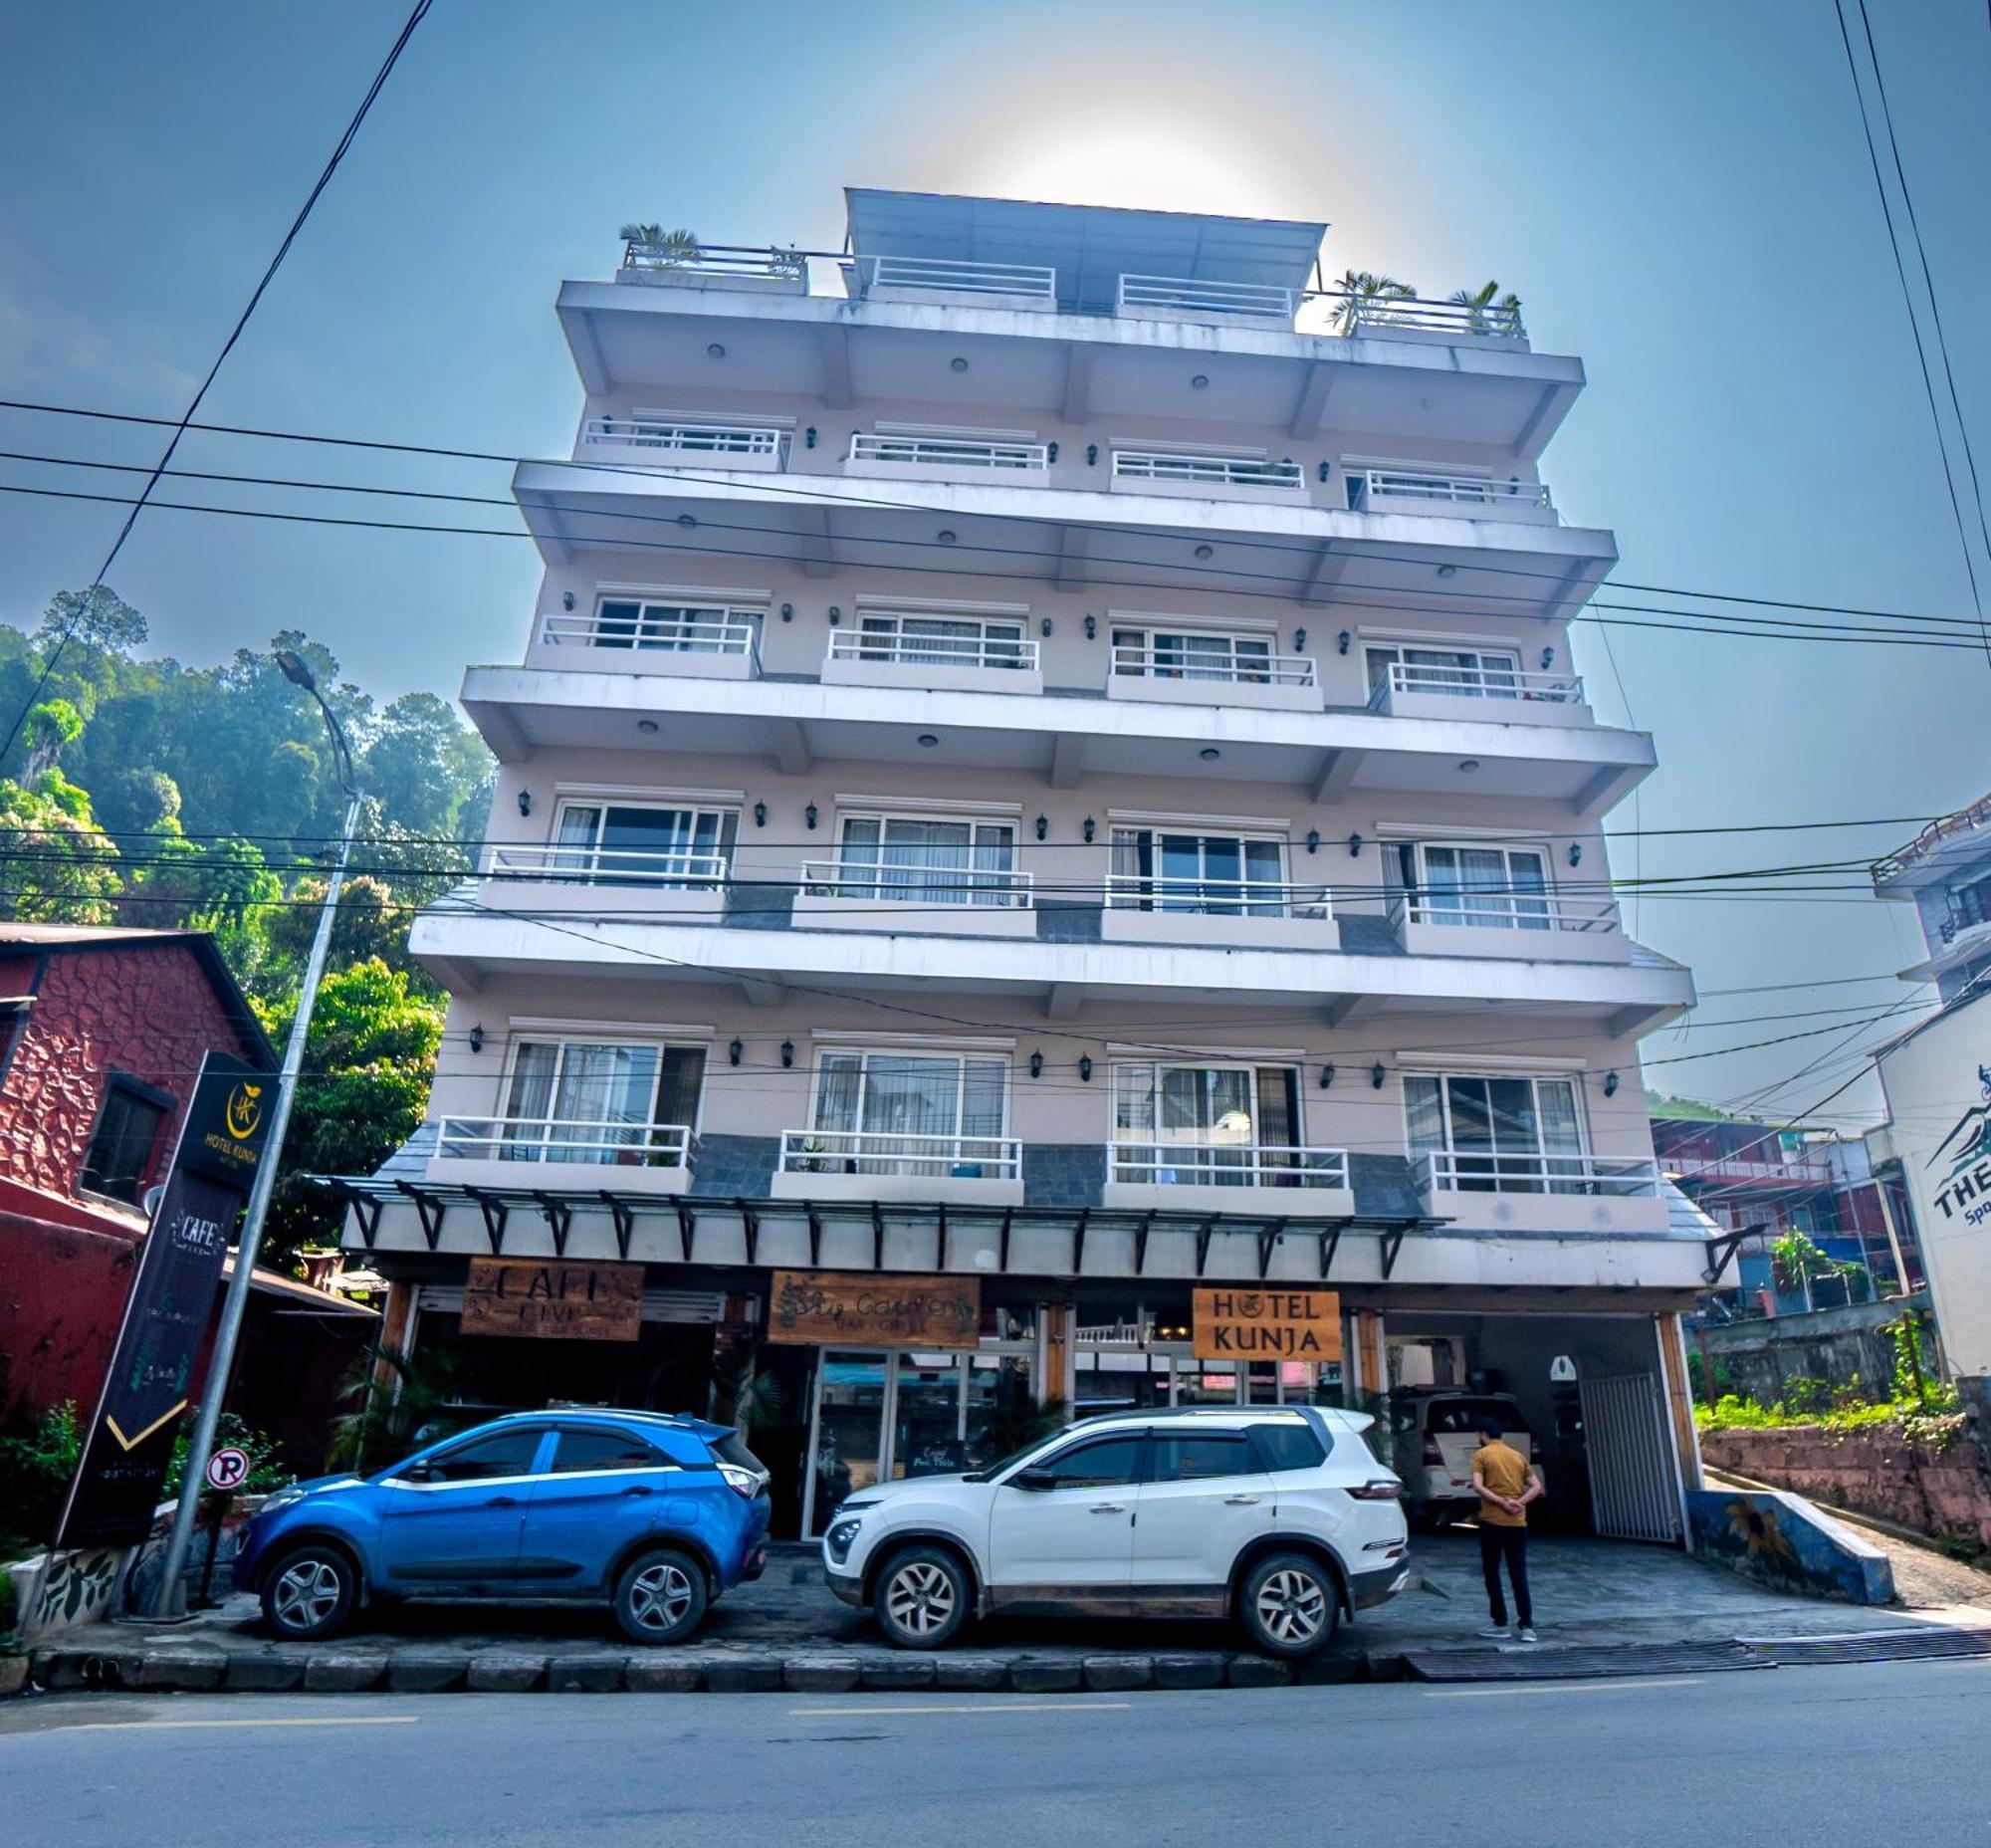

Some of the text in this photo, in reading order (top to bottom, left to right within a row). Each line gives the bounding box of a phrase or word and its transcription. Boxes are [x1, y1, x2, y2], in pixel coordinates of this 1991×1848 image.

[205, 1132, 231, 1154] HOTEL
[1934, 1162, 1991, 1219] THE
[182, 1216, 215, 1246] CAFE
[1214, 1293, 1320, 1319] HOTEL
[1215, 1326, 1321, 1355] KUNJA
[220, 1457, 241, 1481] P
